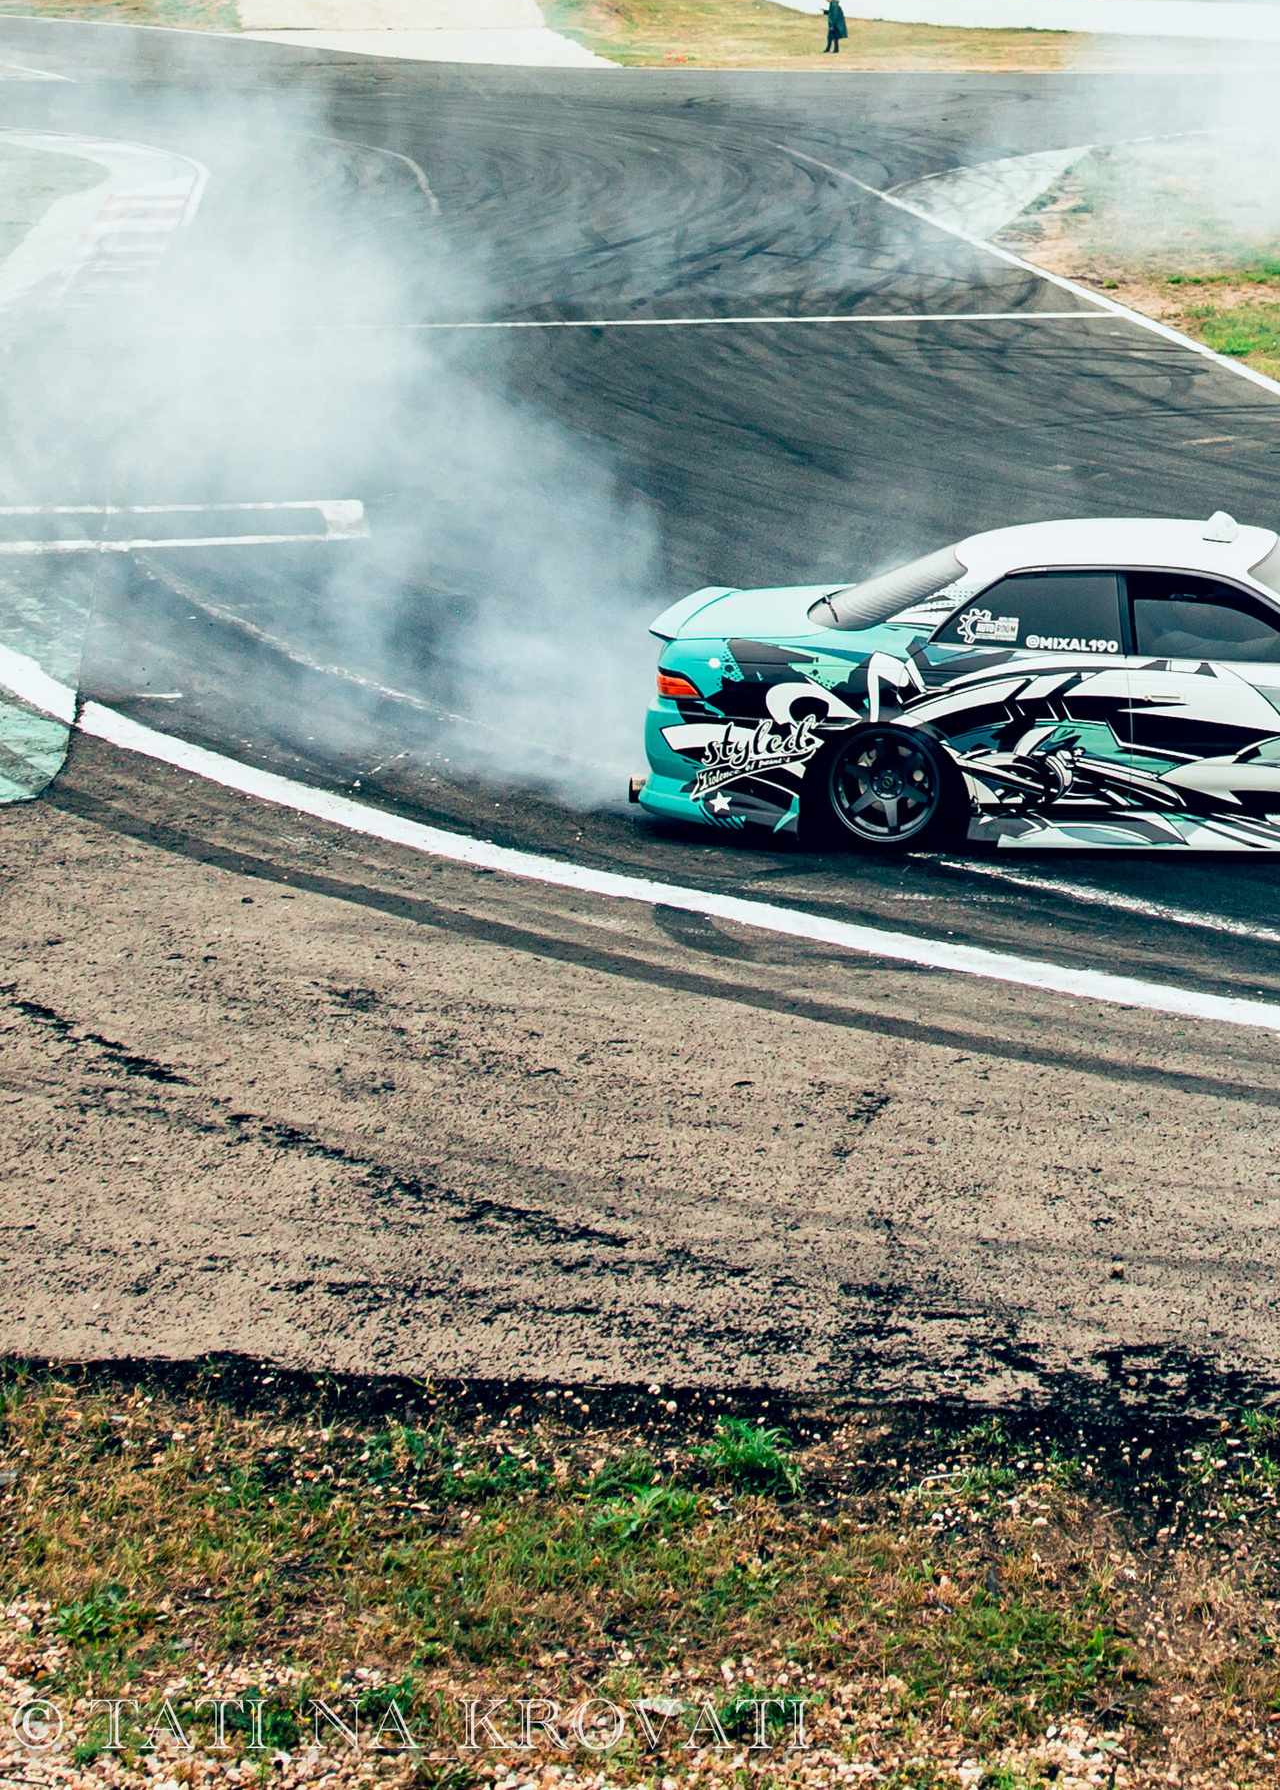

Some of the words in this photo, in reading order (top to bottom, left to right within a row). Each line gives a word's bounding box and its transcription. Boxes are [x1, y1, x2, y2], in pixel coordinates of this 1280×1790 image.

[975, 622, 995, 633] AUTO
[996, 623, 1016, 634] ROOM
[1026, 635, 1118, 653] @MIXAL190
[701, 714, 819, 769] styled
